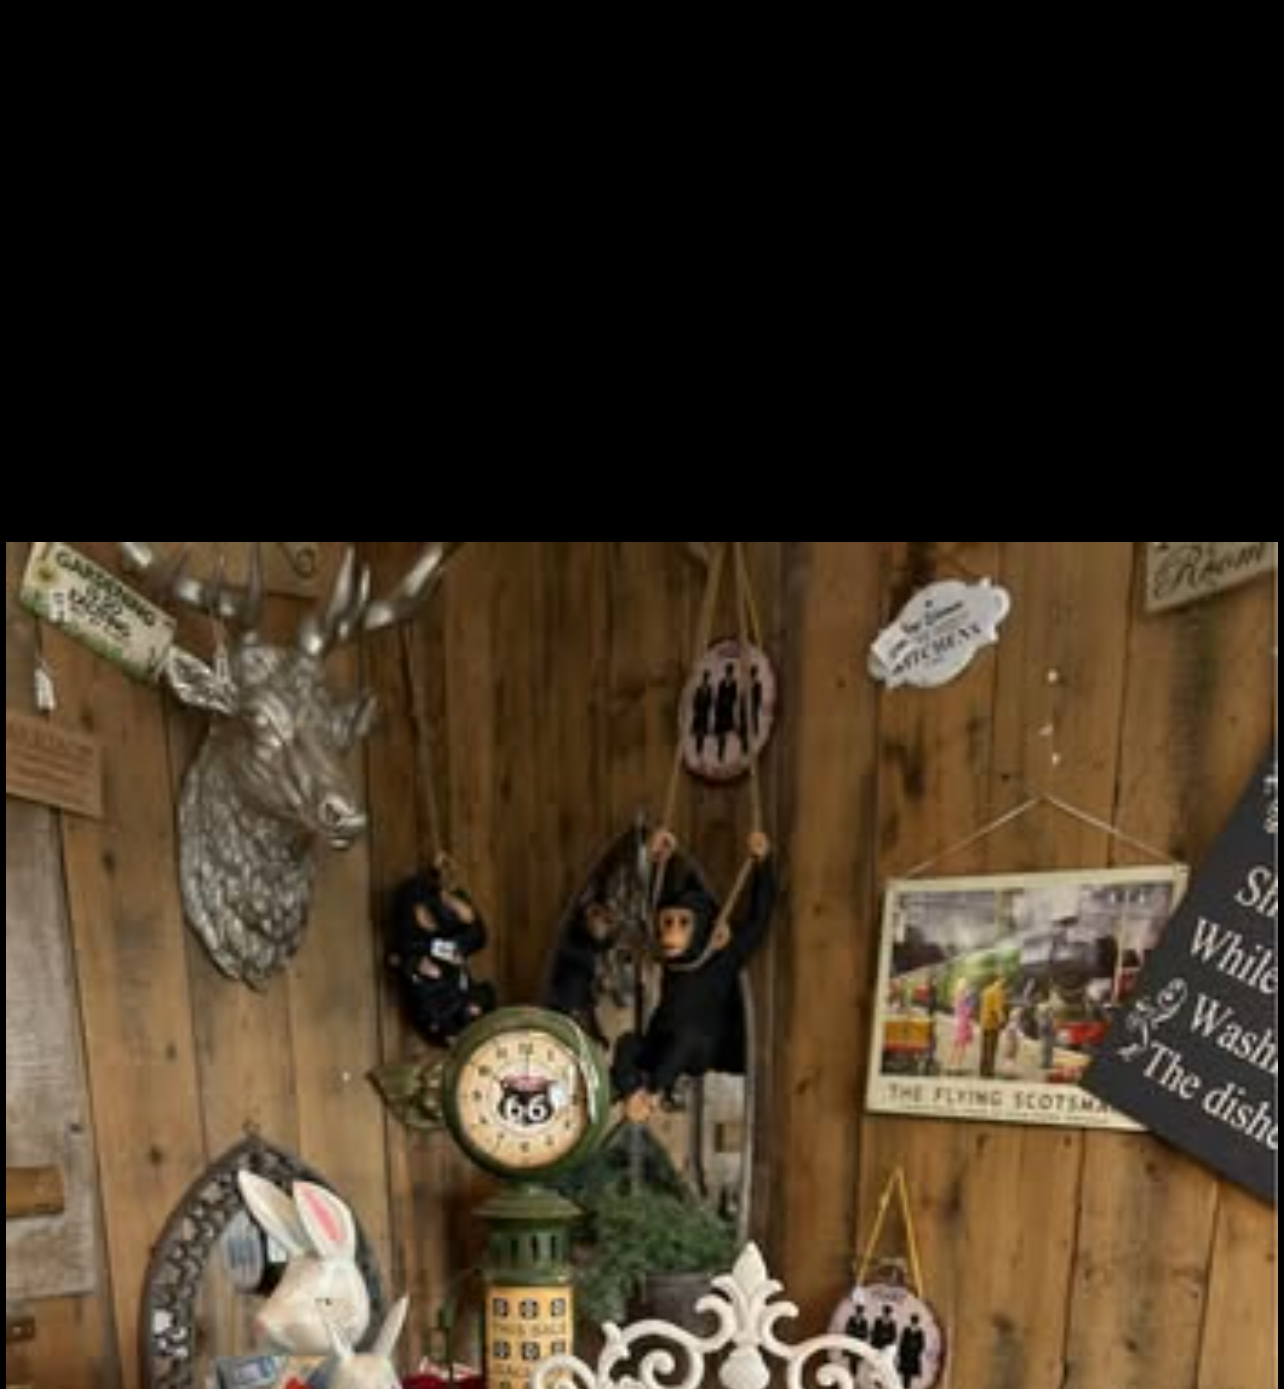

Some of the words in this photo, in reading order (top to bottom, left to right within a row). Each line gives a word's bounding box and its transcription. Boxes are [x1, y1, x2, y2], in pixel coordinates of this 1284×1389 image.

[55, 550, 156, 627] GARDENING
[1190, 916, 1278, 994] While
[886, 1083, 922, 1099] THE
[935, 1086, 1001, 1107] FLYING
[1142, 1039, 1201, 1099] The
[504, 1094, 548, 1122] 66
